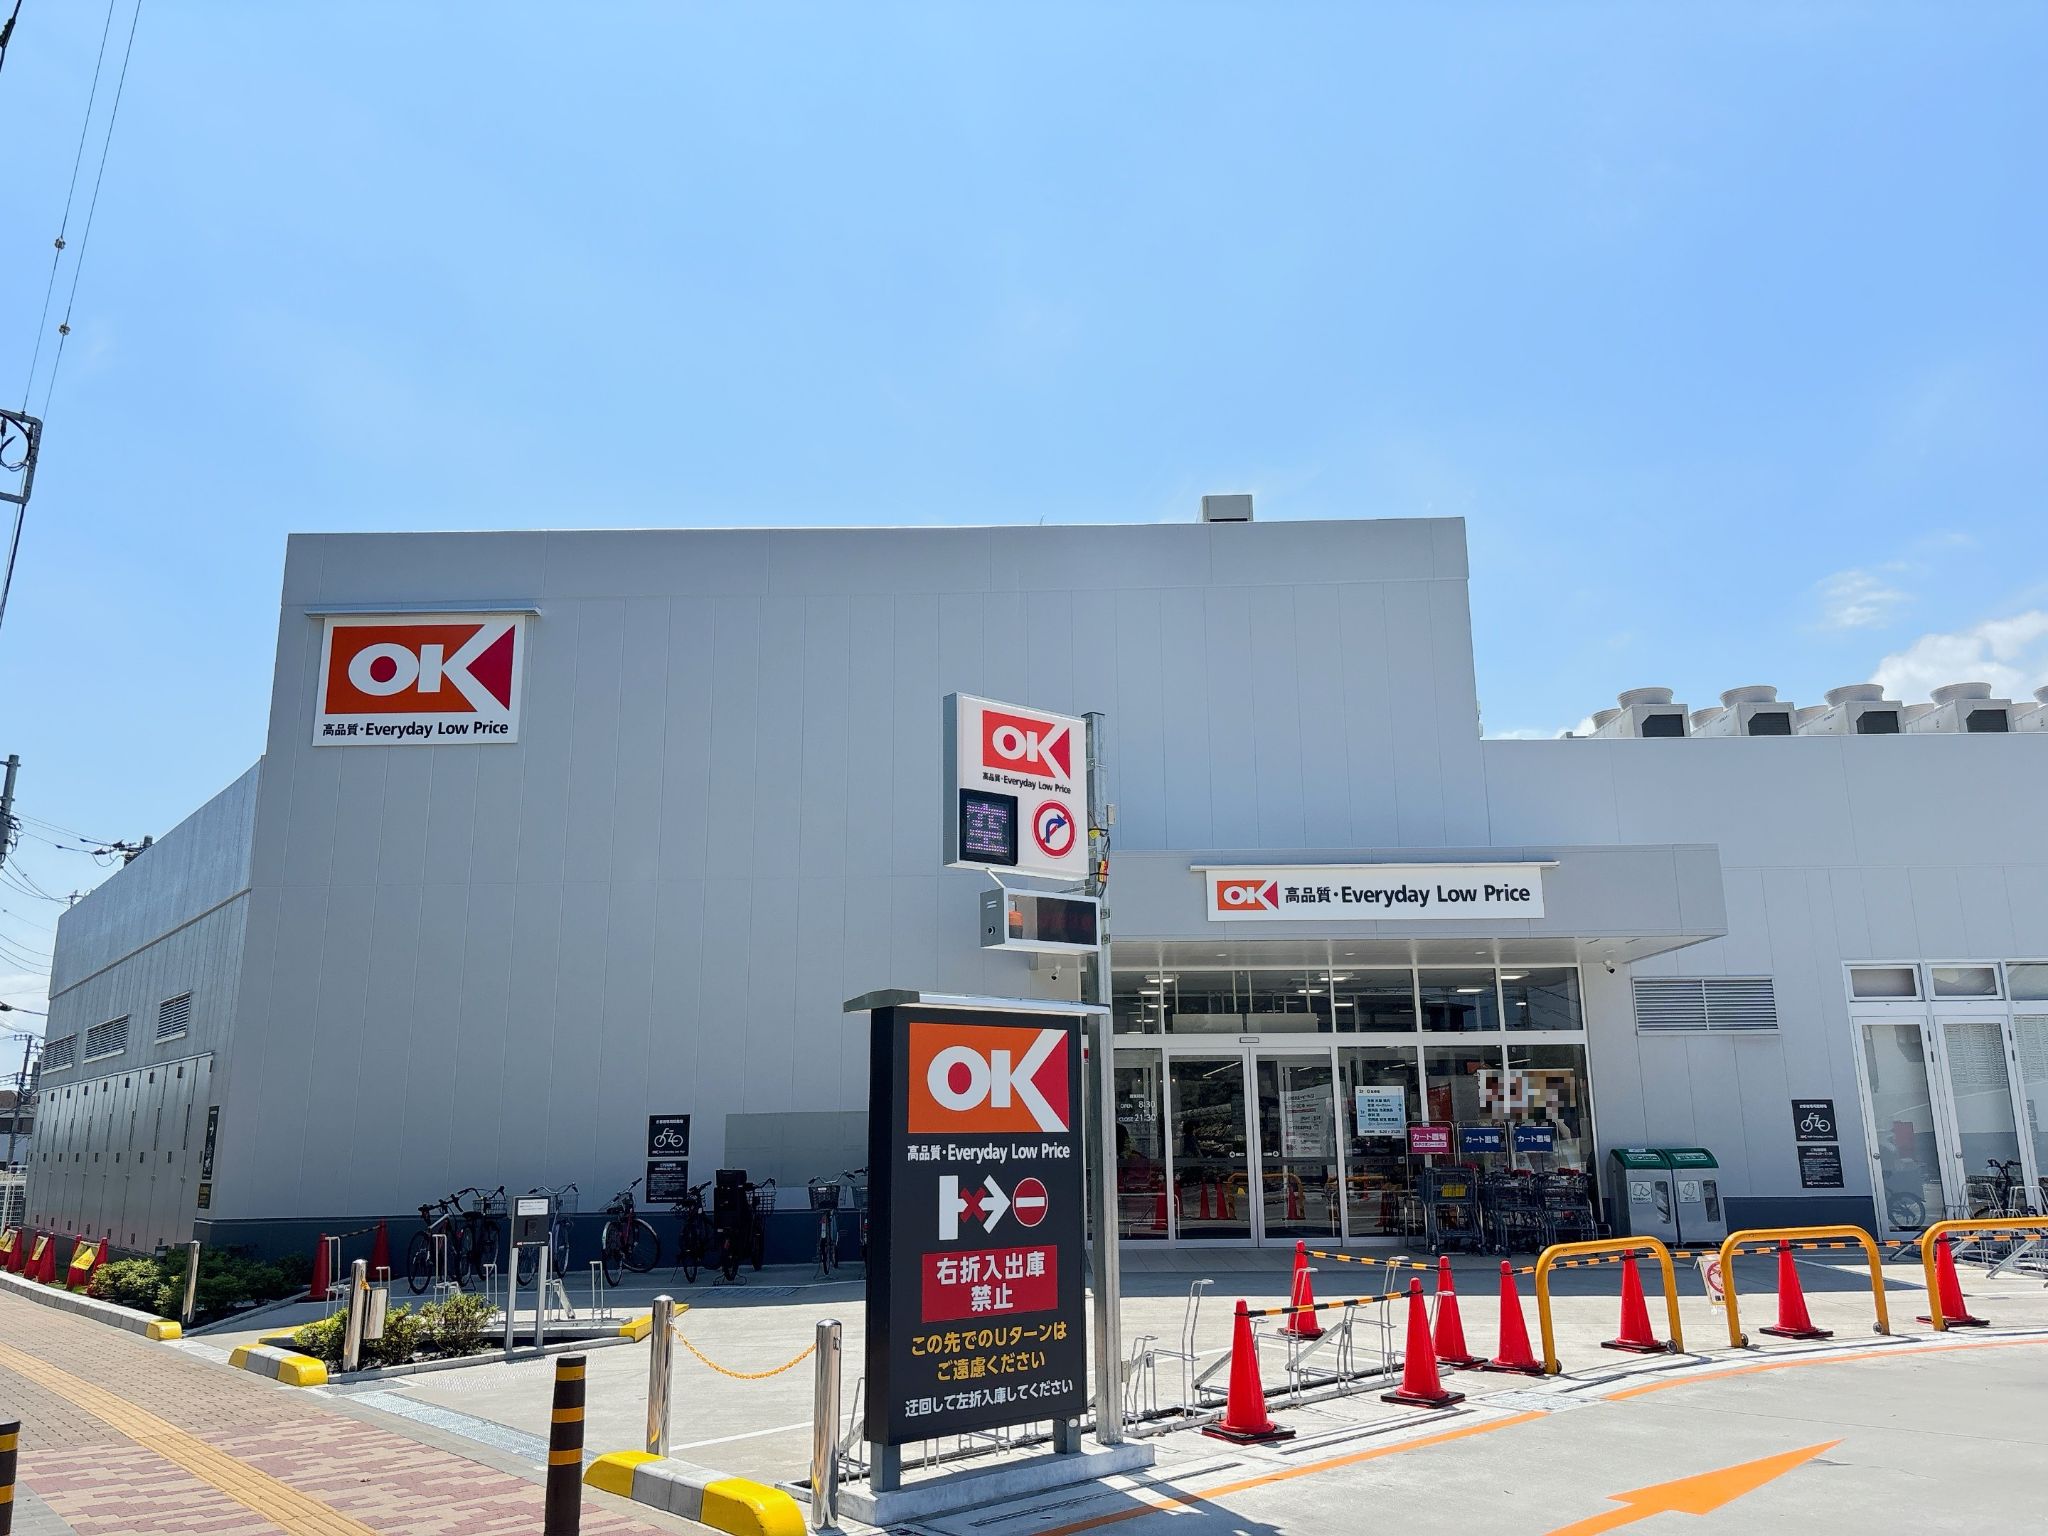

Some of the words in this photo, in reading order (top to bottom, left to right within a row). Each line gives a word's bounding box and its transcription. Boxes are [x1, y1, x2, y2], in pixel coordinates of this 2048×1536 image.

[348, 624, 514, 711] OK
[438, 722, 469, 735] Low
[473, 720, 509, 734] Price
[992, 724, 1069, 779] OK
[1038, 781, 1053, 791] Low
[1055, 784, 1071, 794] Price
[1223, 880, 1278, 910] OK
[1437, 885, 1477, 903] Low
[1484, 883, 1530, 902] Price
[927, 1028, 1069, 1132] OK
[1134, 1113, 1157, 1122] 21:30
[1138, 1100, 1156, 1109] 8:30
[1012, 1143, 1038, 1159] Low
[1042, 1142, 1070, 1159] Price
[936, 1250, 1046, 1286] 右折入出庫
[970, 1283, 1014, 1312] 禁止
[911, 1321, 1067, 1356] この先でのUターンは
[936, 1351, 1046, 1381] ご遠慮ください
[904, 1379, 1074, 1418] 迂回して左折入庫してください
